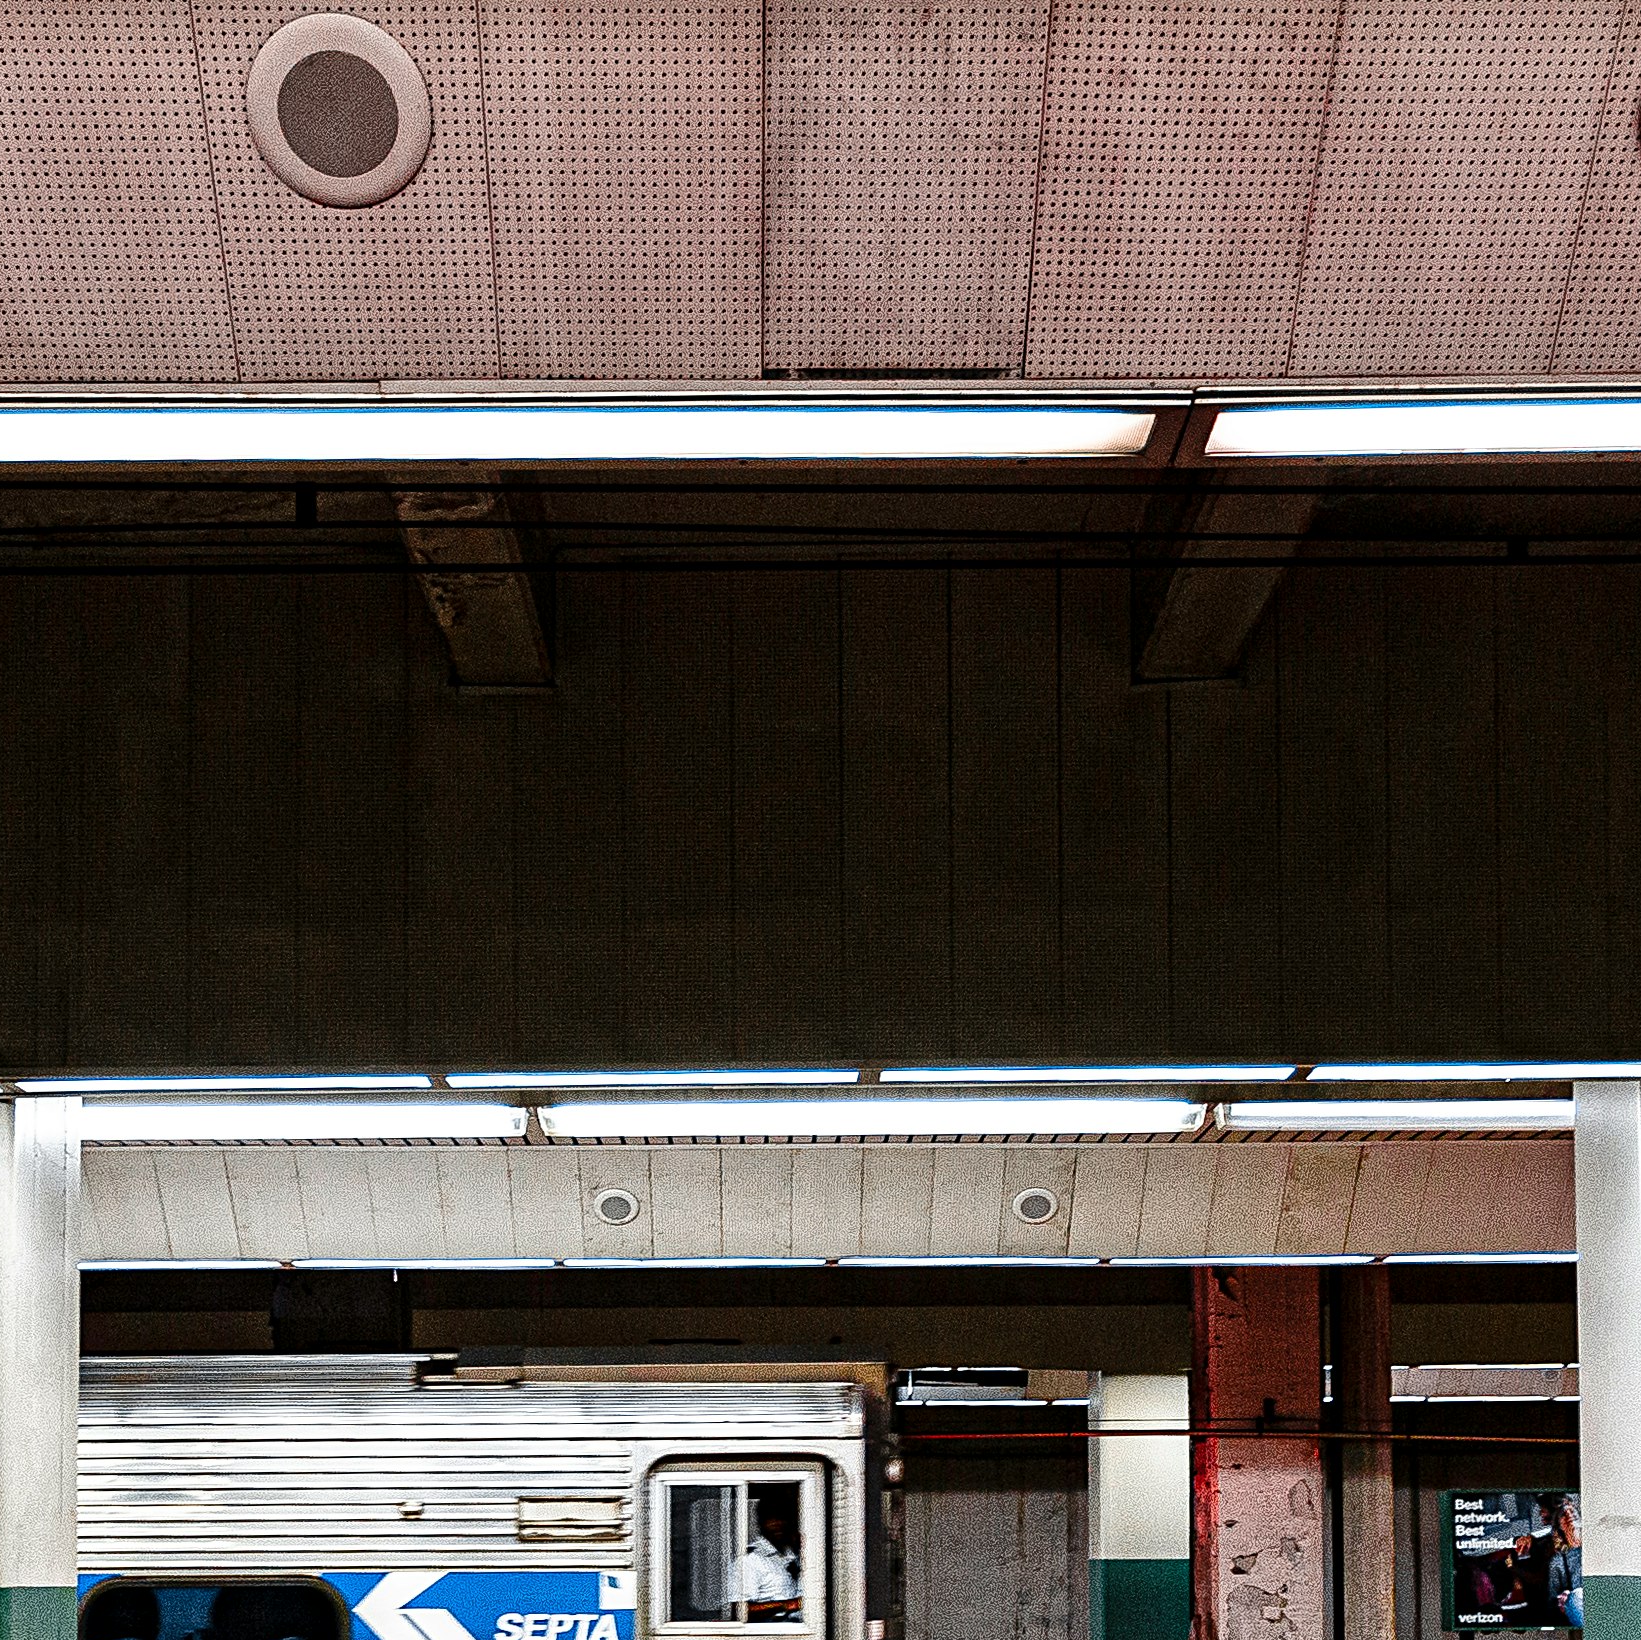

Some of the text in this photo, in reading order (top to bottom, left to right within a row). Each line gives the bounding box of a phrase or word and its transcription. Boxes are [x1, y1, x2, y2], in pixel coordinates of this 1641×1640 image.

[1454, 1499, 1483, 1510] Best
[1454, 1511, 1510, 1523] network.
[1455, 1525, 1485, 1536] Best
[1456, 1537, 1517, 1549] unlimited.
[1458, 1612, 1503, 1623] verizon
